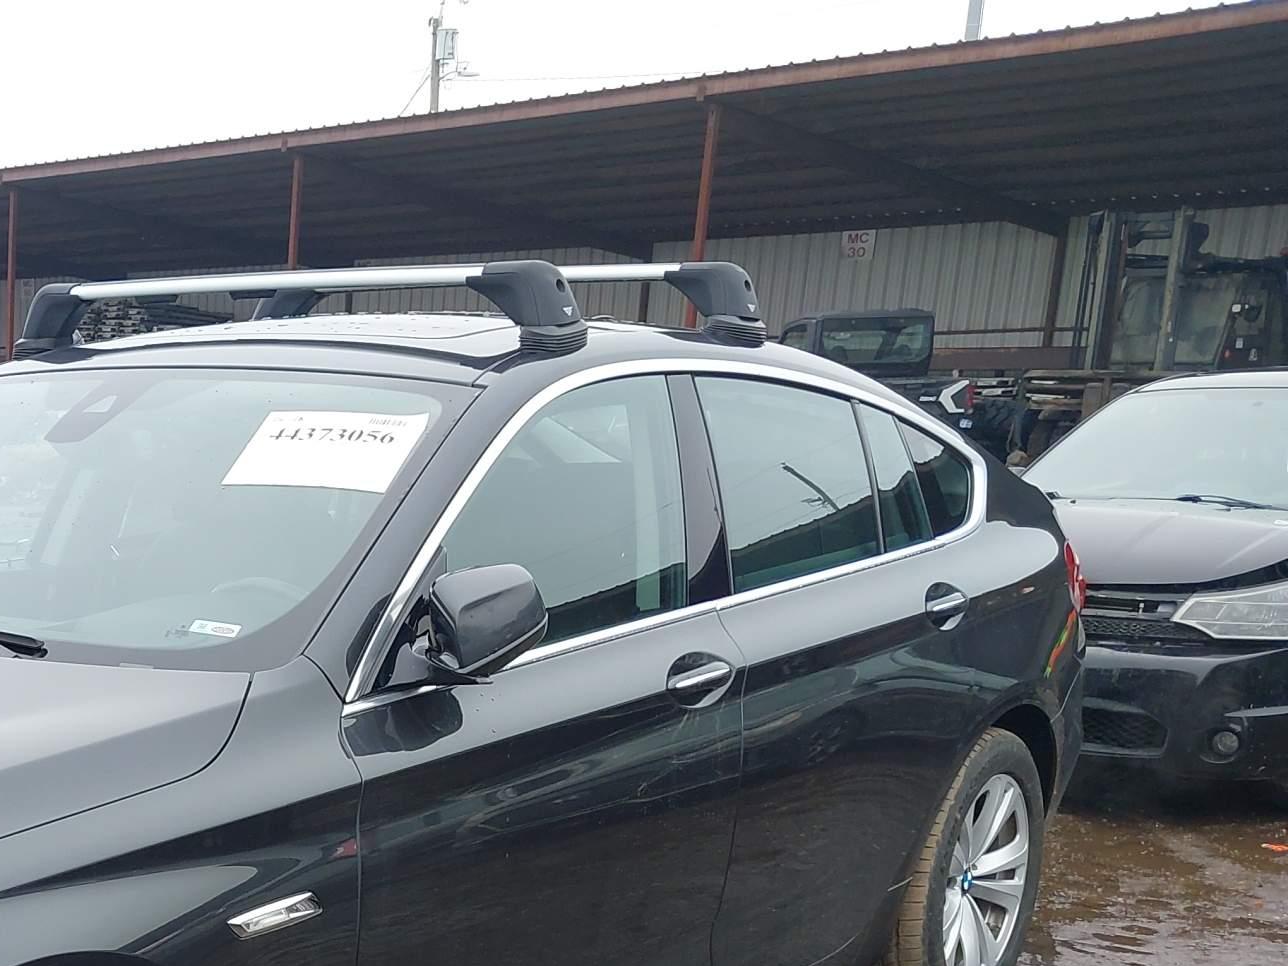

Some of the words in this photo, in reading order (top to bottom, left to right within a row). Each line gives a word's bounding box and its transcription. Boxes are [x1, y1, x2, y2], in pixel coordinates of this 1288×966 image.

[847, 232, 870, 244] MC
[847, 246, 866, 258] 30
[269, 427, 396, 444] 44373056
